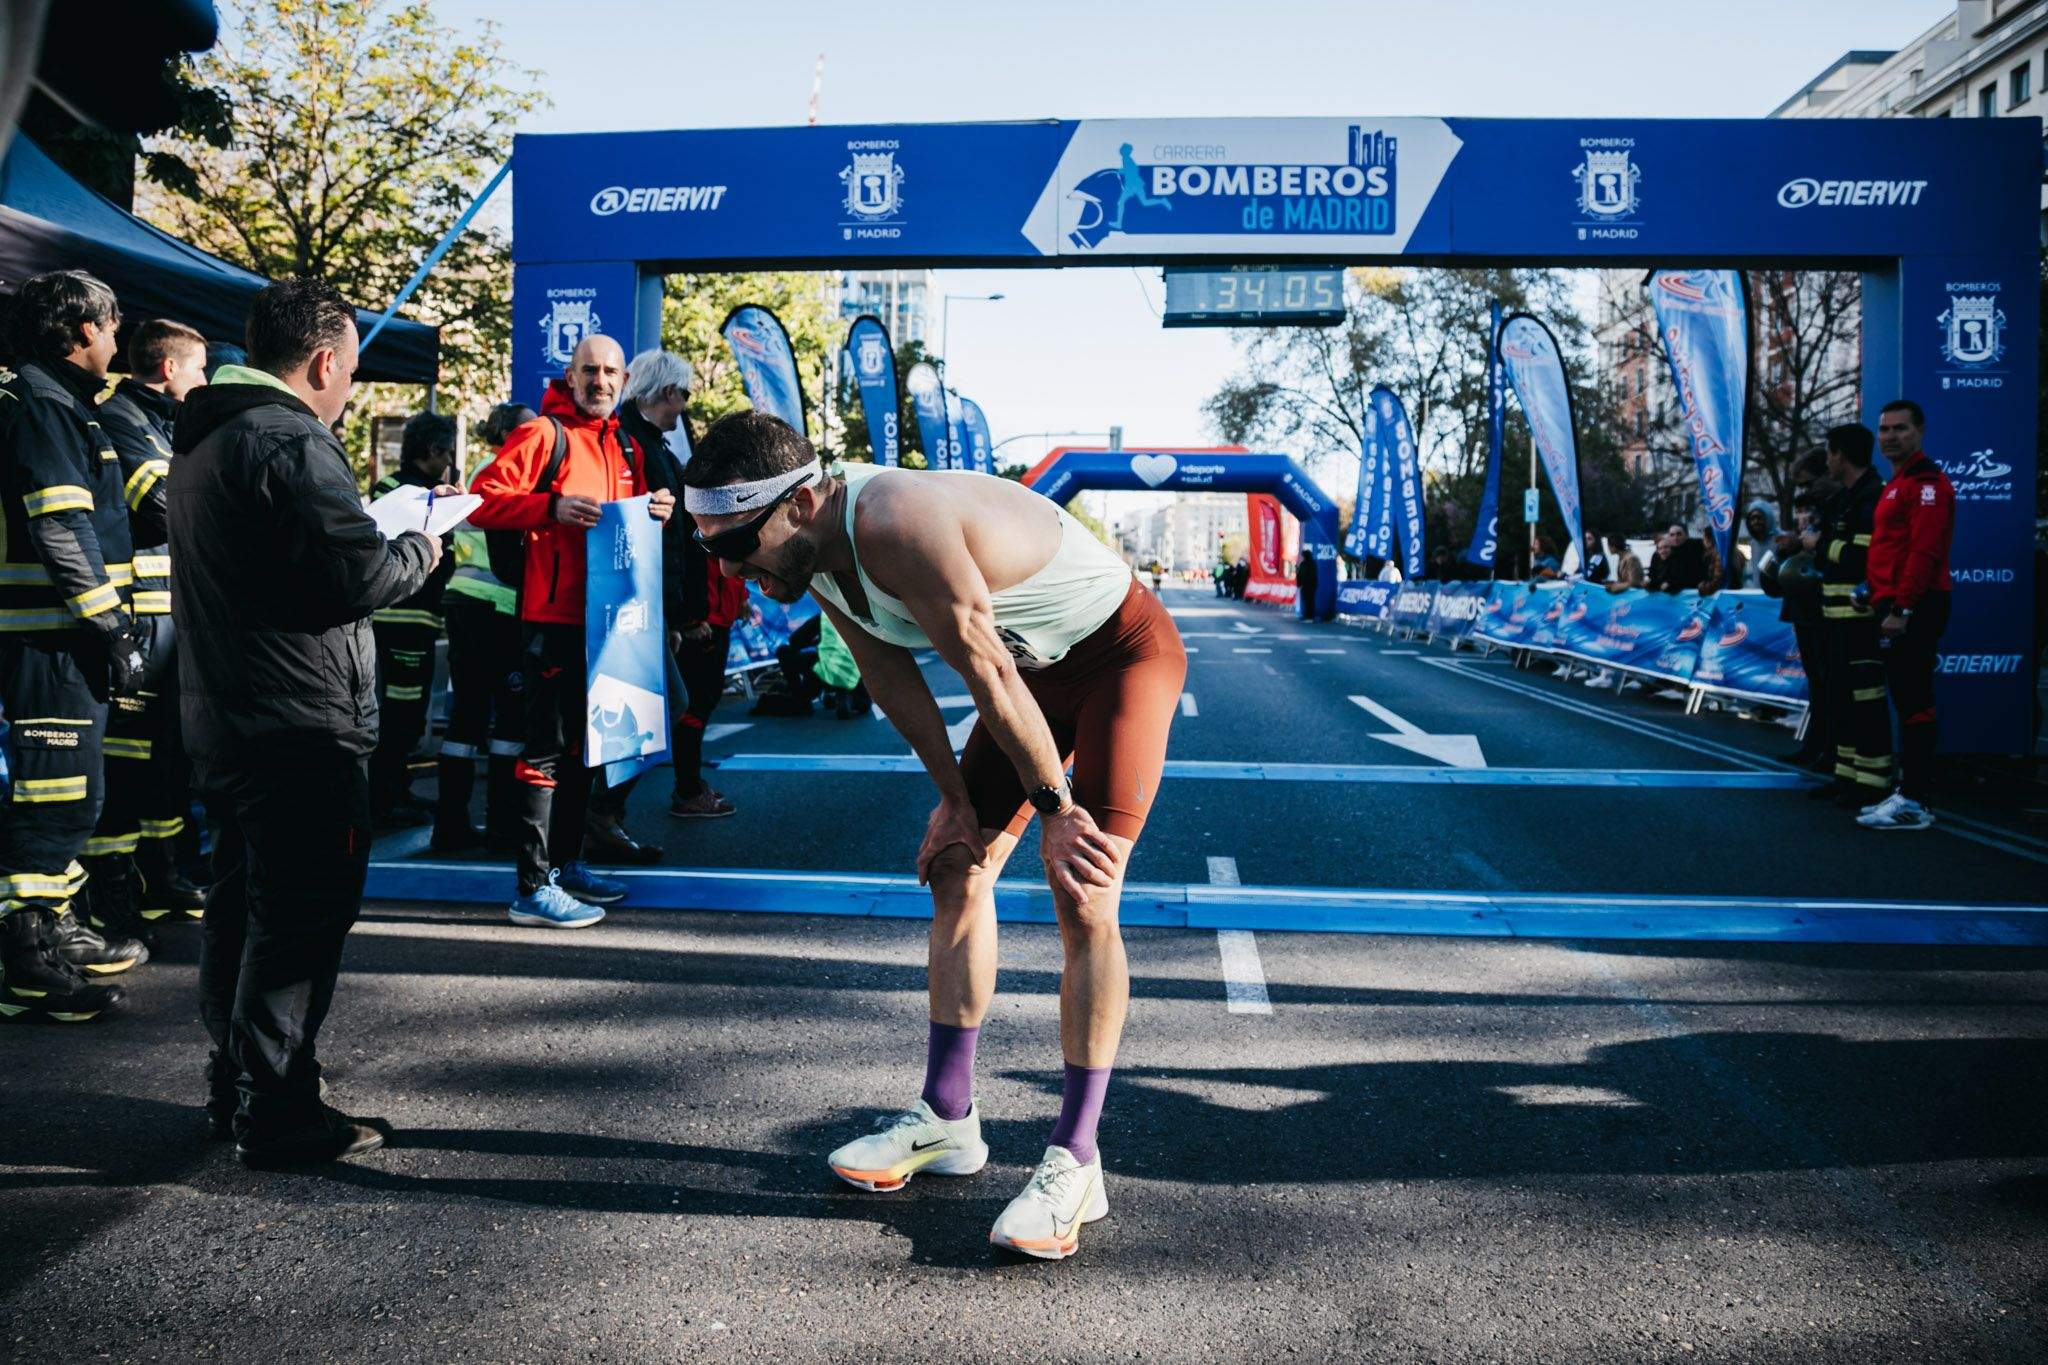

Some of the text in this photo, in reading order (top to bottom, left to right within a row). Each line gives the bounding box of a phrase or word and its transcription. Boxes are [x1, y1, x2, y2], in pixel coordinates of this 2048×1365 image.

[847, 140, 900, 151] BOMBEROS
[1579, 137, 1636, 148] BOMBEROS
[1152, 145, 1227, 160] CARRERA
[1151, 165, 1389, 197] BOMBEROS
[626, 185, 728, 212] ENERVIT
[1817, 180, 1928, 206] ENERVIT
[1242, 198, 1390, 231] de MADRID
[857, 228, 902, 240] MADRID
[1592, 228, 1639, 239] MADRID
[546, 288, 597, 299] BOMBEROS
[1946, 282, 2002, 293] BOMBEROS
[1957, 377, 2004, 388] MADRID
[1951, 480, 2012, 494] eportivo
[1949, 569, 2015, 583] MADRID
[1942, 654, 2022, 674] ENERVIT
[24, 729, 79, 739] BOMBEROS
[46, 738, 79, 747] MADRID
